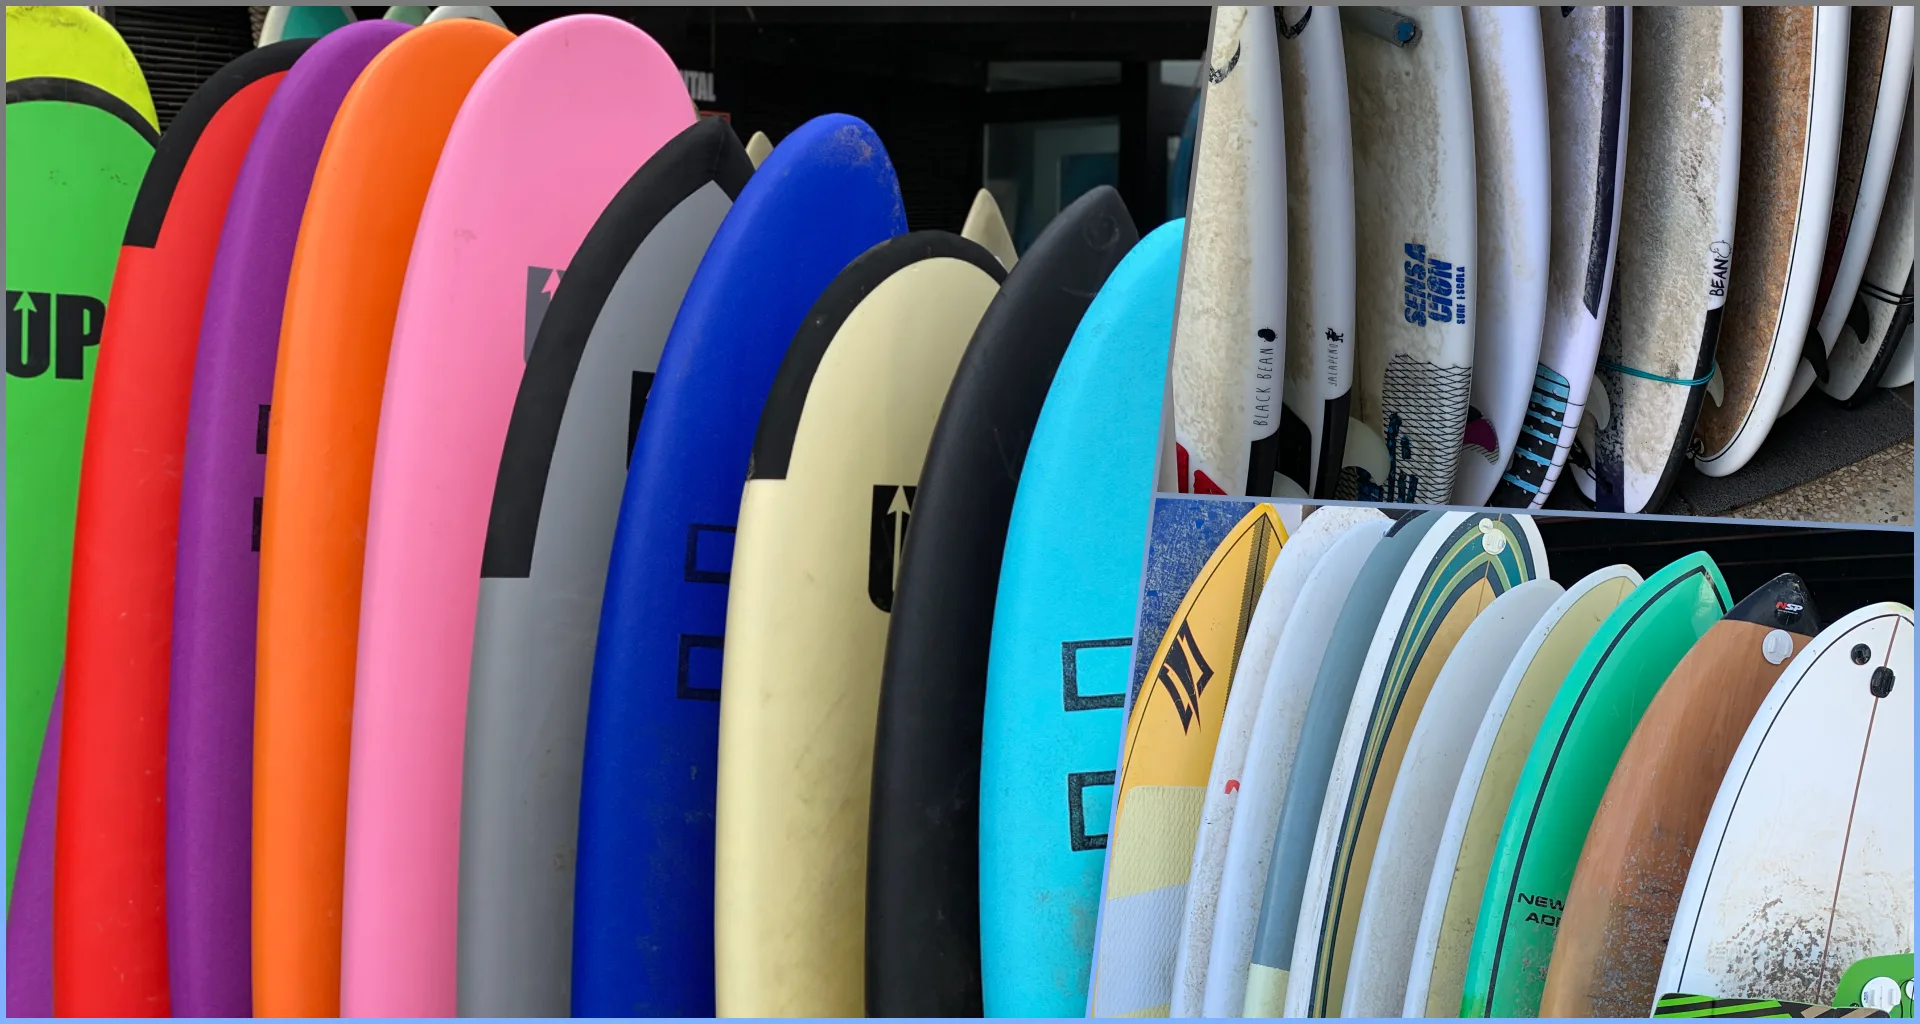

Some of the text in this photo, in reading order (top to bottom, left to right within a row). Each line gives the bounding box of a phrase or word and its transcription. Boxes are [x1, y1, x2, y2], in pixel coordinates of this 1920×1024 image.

[1404, 242, 1427, 327] SENSA
[1709, 259, 1729, 297] BEAN
[1456, 304, 1466, 325] SURF
[6, 290, 106, 380] UP
[1253, 348, 1274, 426] BLACK BEAN
[1775, 601, 1804, 612] NSP
[1517, 892, 1565, 911] NEW
